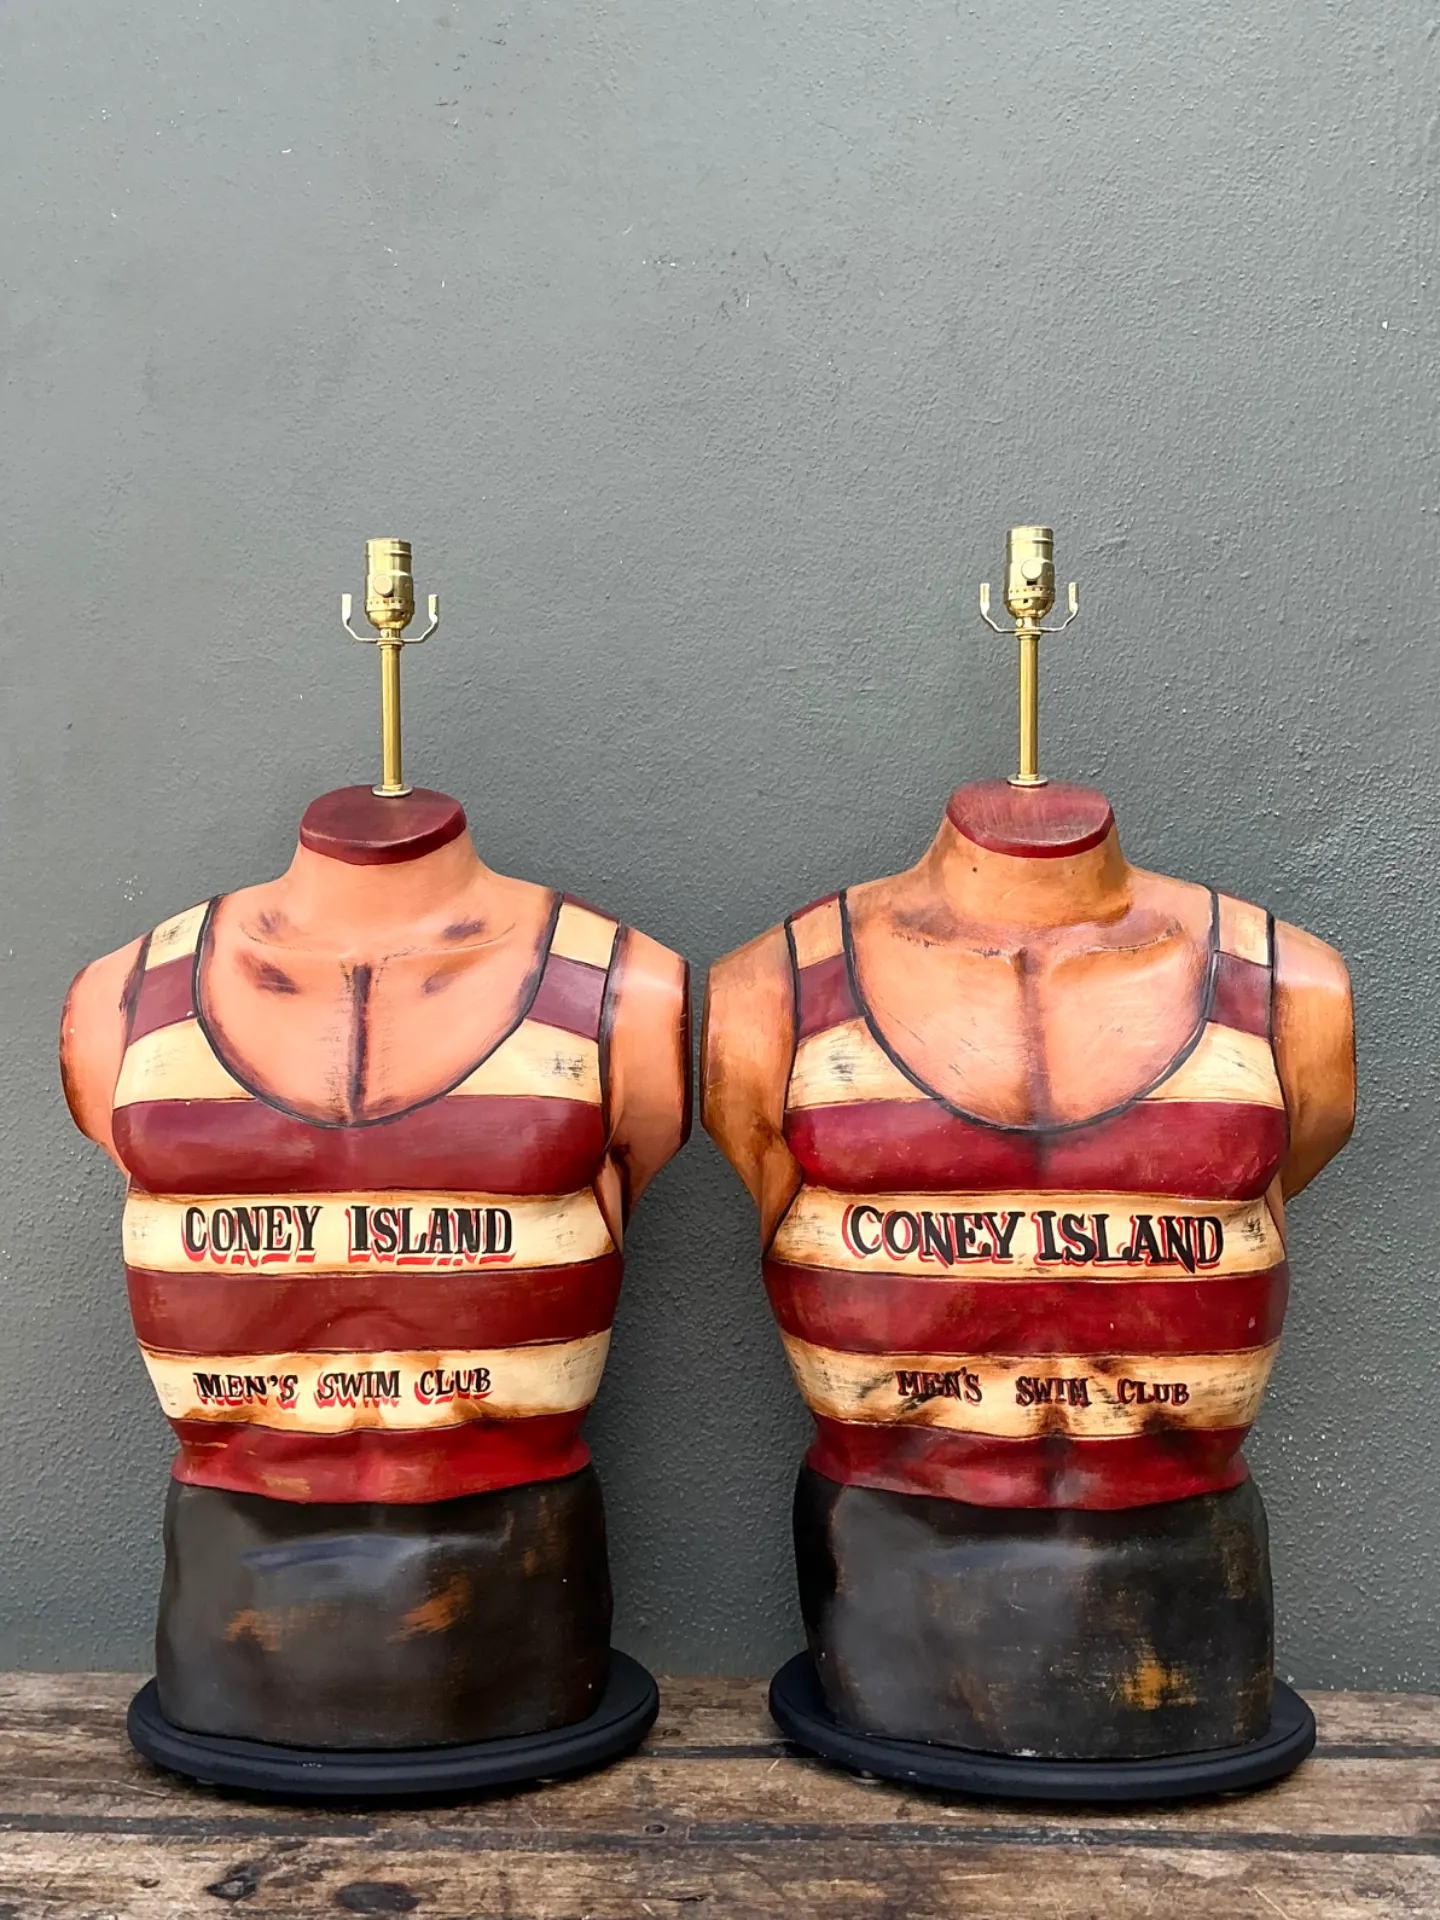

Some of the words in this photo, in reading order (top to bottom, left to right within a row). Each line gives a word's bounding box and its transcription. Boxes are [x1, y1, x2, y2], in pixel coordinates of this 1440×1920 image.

[182, 1205, 323, 1266] CONEY
[346, 1205, 516, 1265] ISLAND
[842, 1204, 1025, 1268] CONEY
[1031, 1210, 1224, 1274] ISLAND
[193, 1372, 298, 1409] MEN'S
[314, 1371, 400, 1409] SWIM
[414, 1368, 492, 1405] CLUB
[896, 1367, 983, 1406] MEN'S
[1016, 1376, 1092, 1407] SWIM
[1117, 1377, 1190, 1406] CLUB
